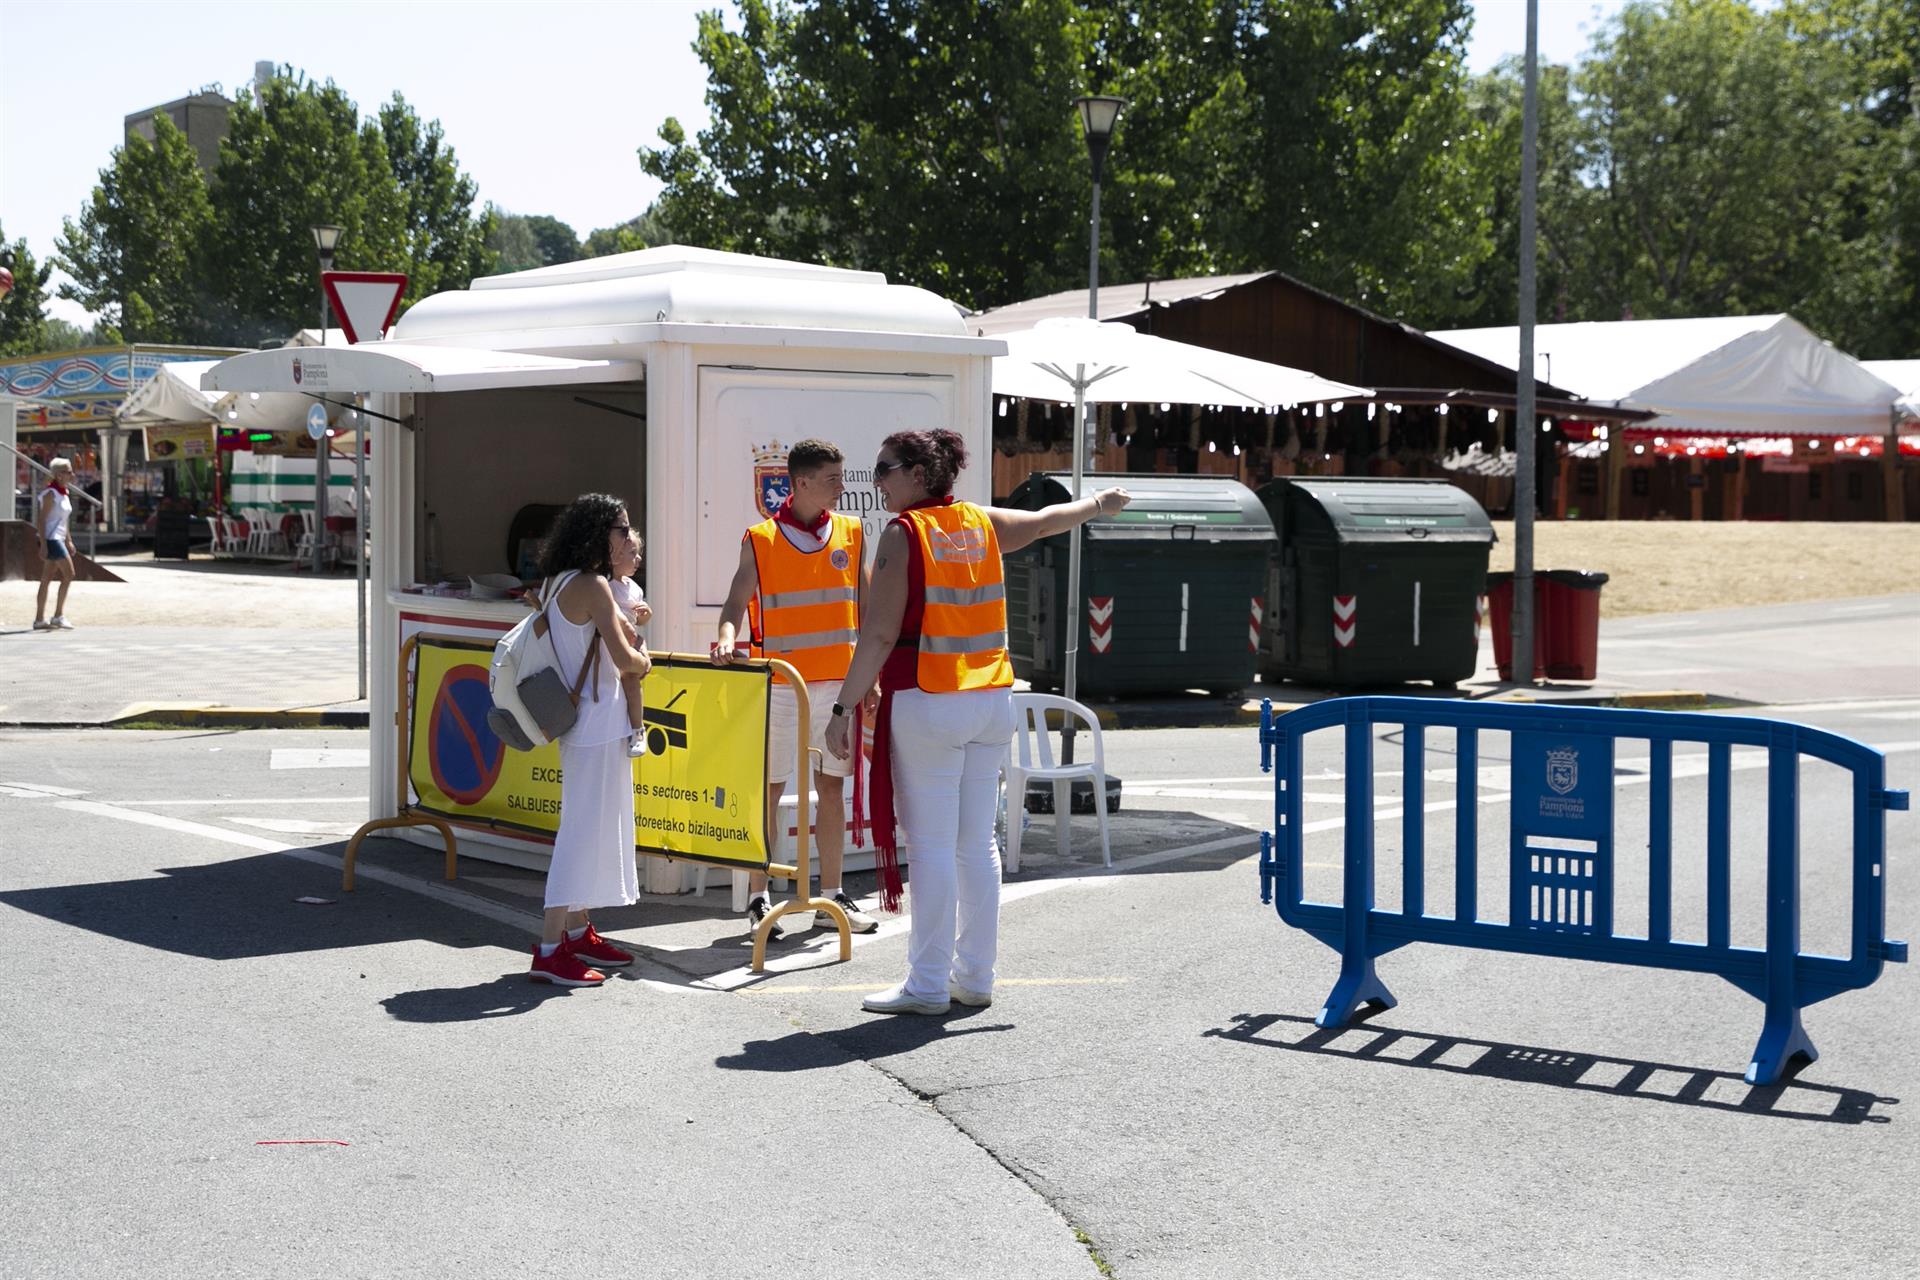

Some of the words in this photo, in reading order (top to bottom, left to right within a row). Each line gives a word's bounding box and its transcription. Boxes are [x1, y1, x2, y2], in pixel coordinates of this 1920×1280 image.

[532, 766, 563, 784] EXCE
[652, 784, 699, 803] sectores
[507, 794, 563, 815] SALBUESP
[634, 812, 685, 834] ktoreetako
[688, 820, 750, 842] bizilagunak
[1540, 800, 1584, 813] Pamplona
